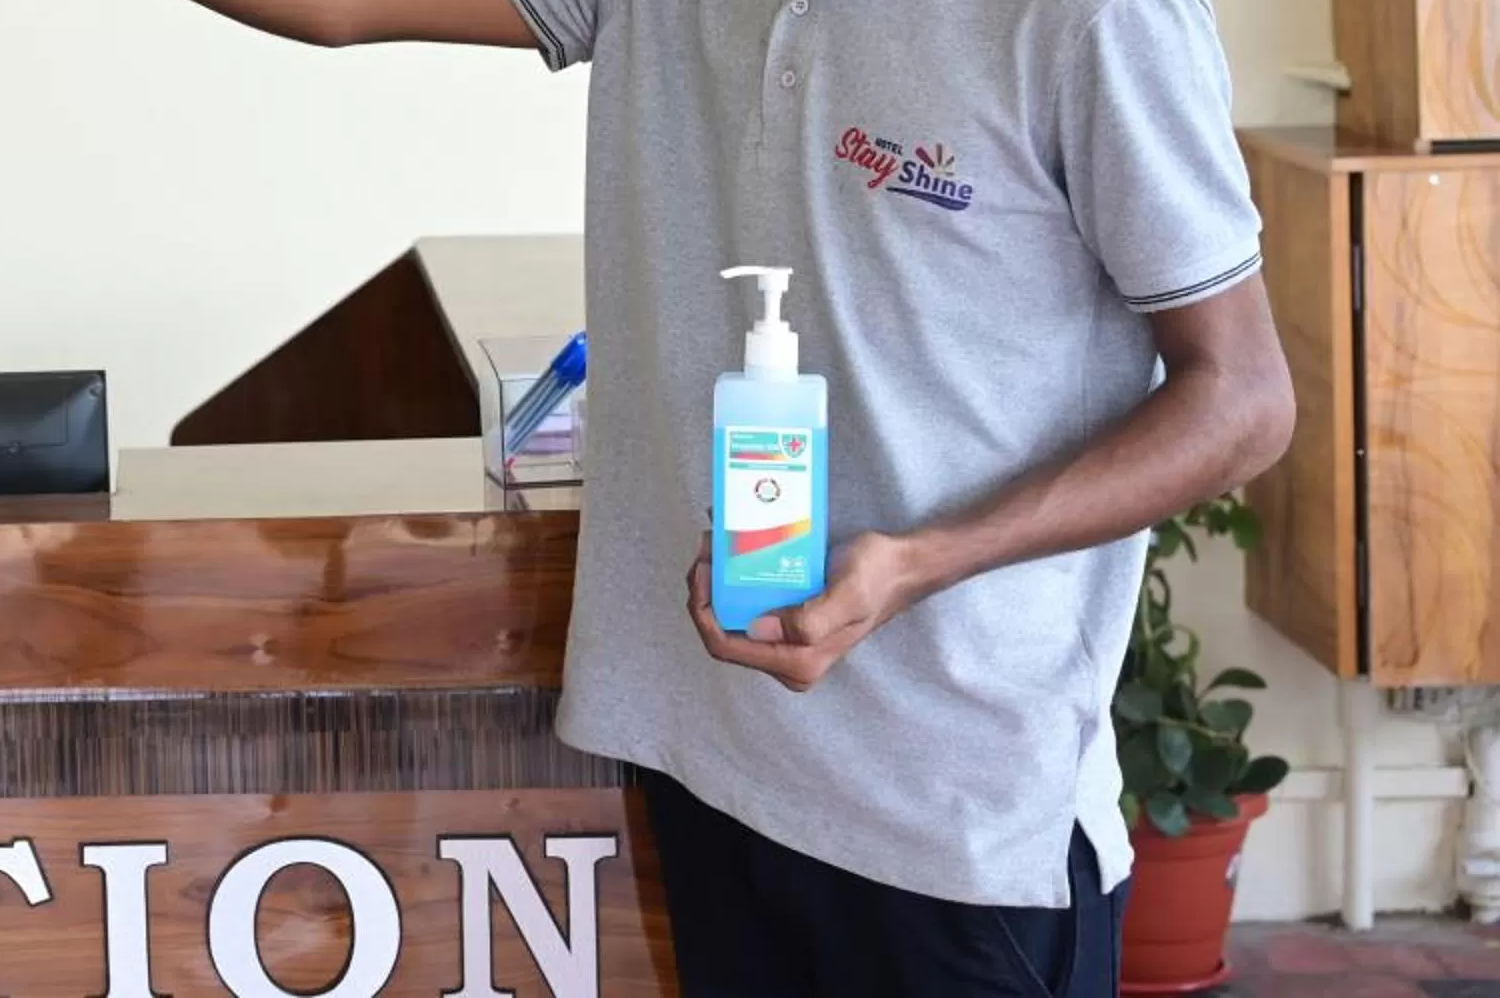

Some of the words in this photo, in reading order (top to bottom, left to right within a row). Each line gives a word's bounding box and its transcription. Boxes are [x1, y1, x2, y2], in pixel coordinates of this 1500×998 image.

[835, 127, 899, 189] Stay
[899, 160, 973, 200] Shine
[875, 137, 903, 155] HOTEL
